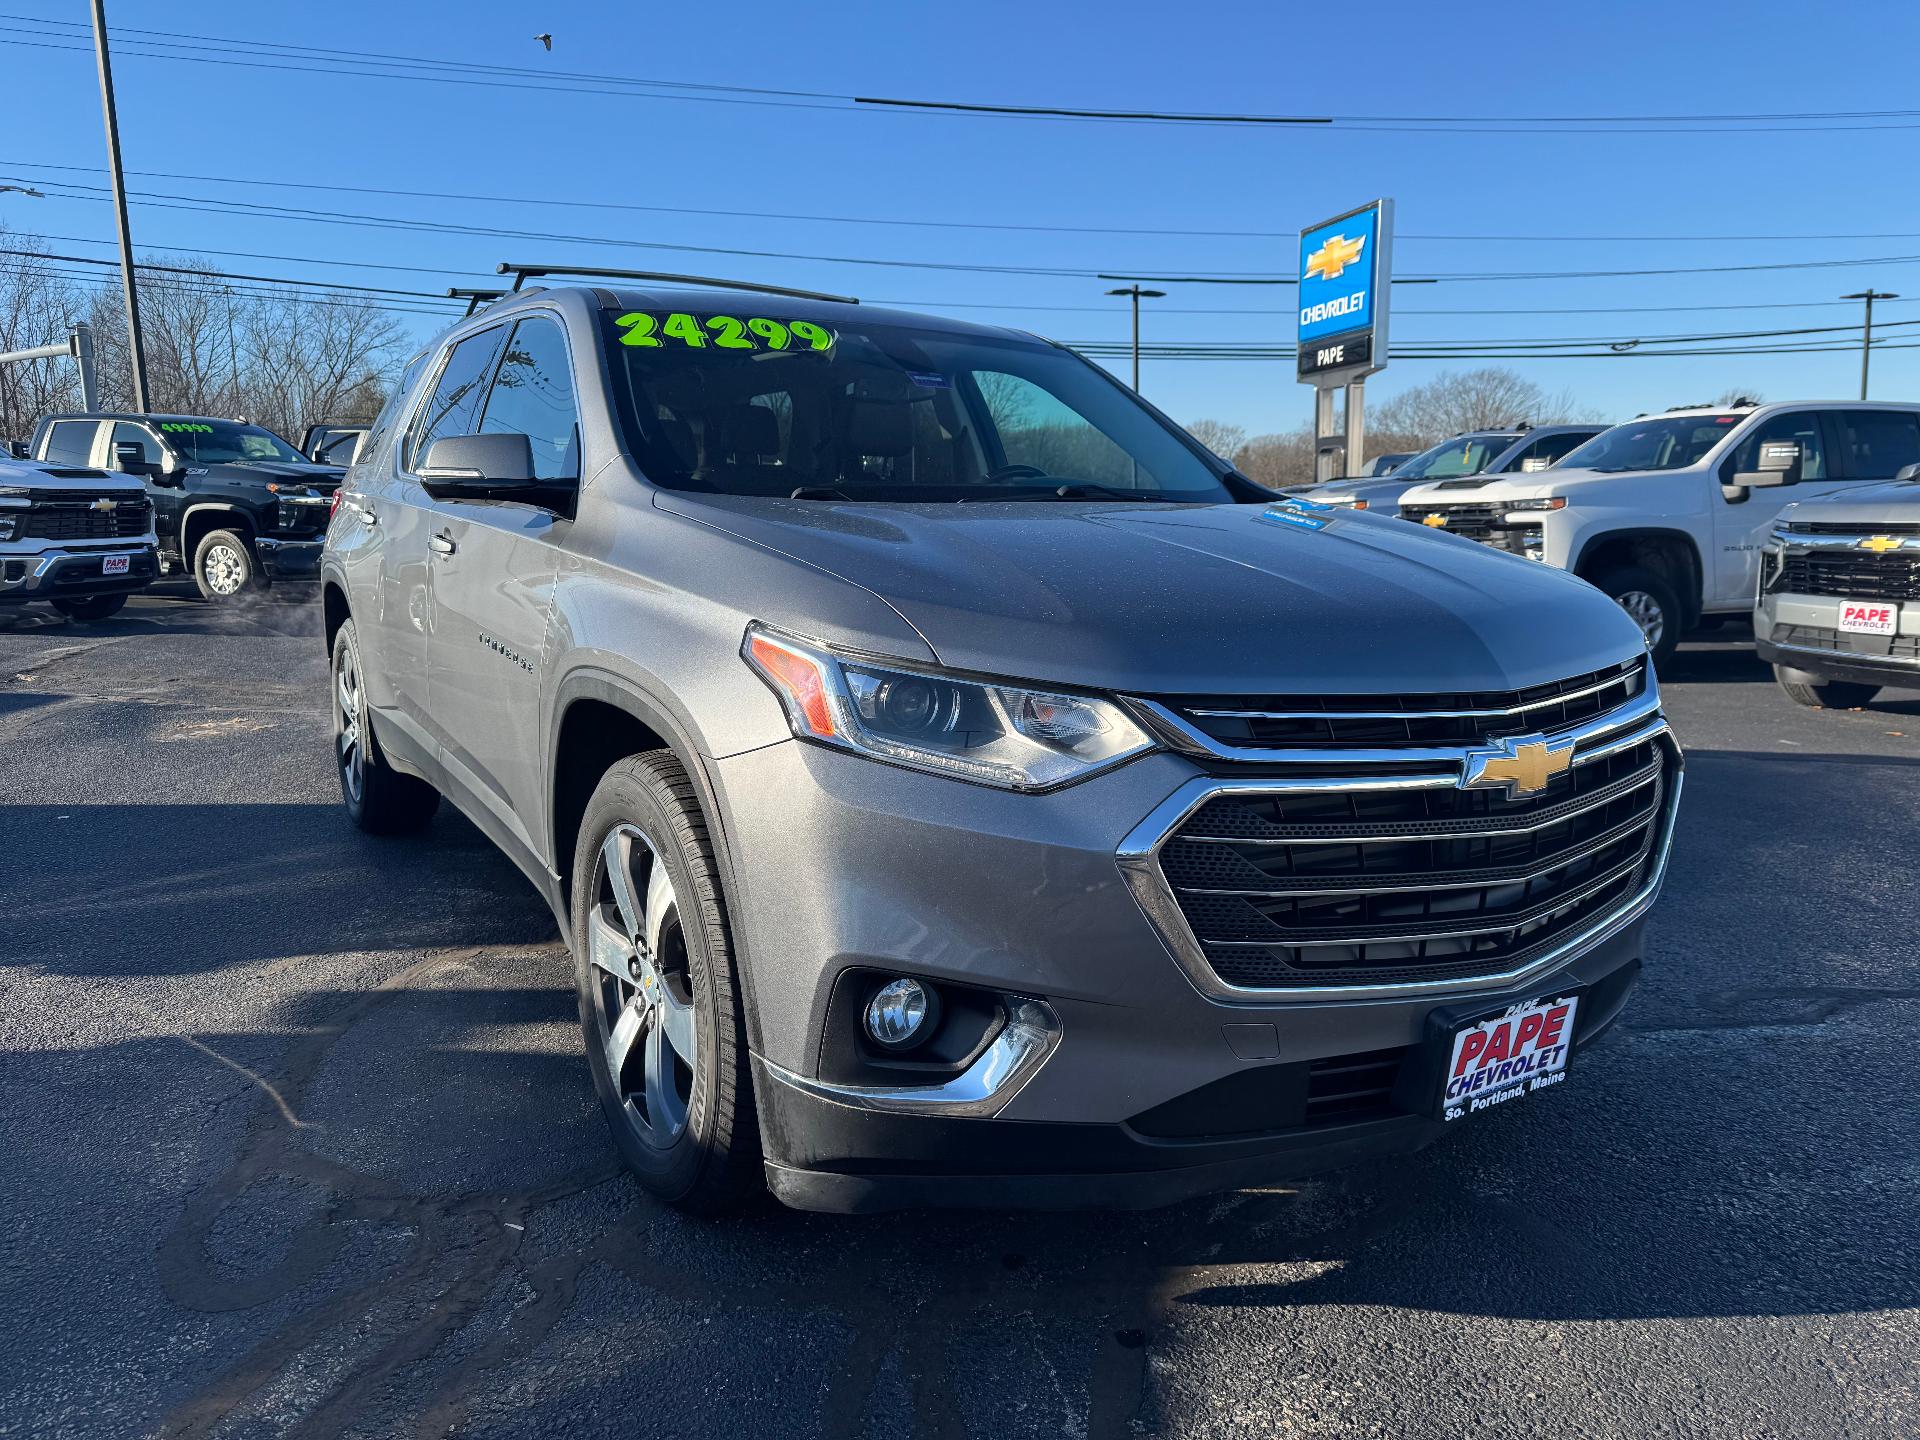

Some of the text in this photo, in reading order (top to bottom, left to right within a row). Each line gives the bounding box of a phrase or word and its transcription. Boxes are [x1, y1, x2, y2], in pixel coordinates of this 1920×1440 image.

[1300, 291, 1366, 325] CHEVROLET
[614, 312, 834, 351] 24299
[1317, 345, 1345, 366] PAPE
[161, 423, 213, 433] 49999
[106, 558, 128, 567] PAPE
[1842, 619, 1892, 629] CHEVROLET
[1844, 607, 1890, 622] PAPE
[1504, 998, 1540, 1018] PAPE
[1452, 1004, 1570, 1078] PAPE
[1446, 1044, 1566, 1100] CHEVROLET
[1445, 1071, 1566, 1121] So. Portland, Maine
